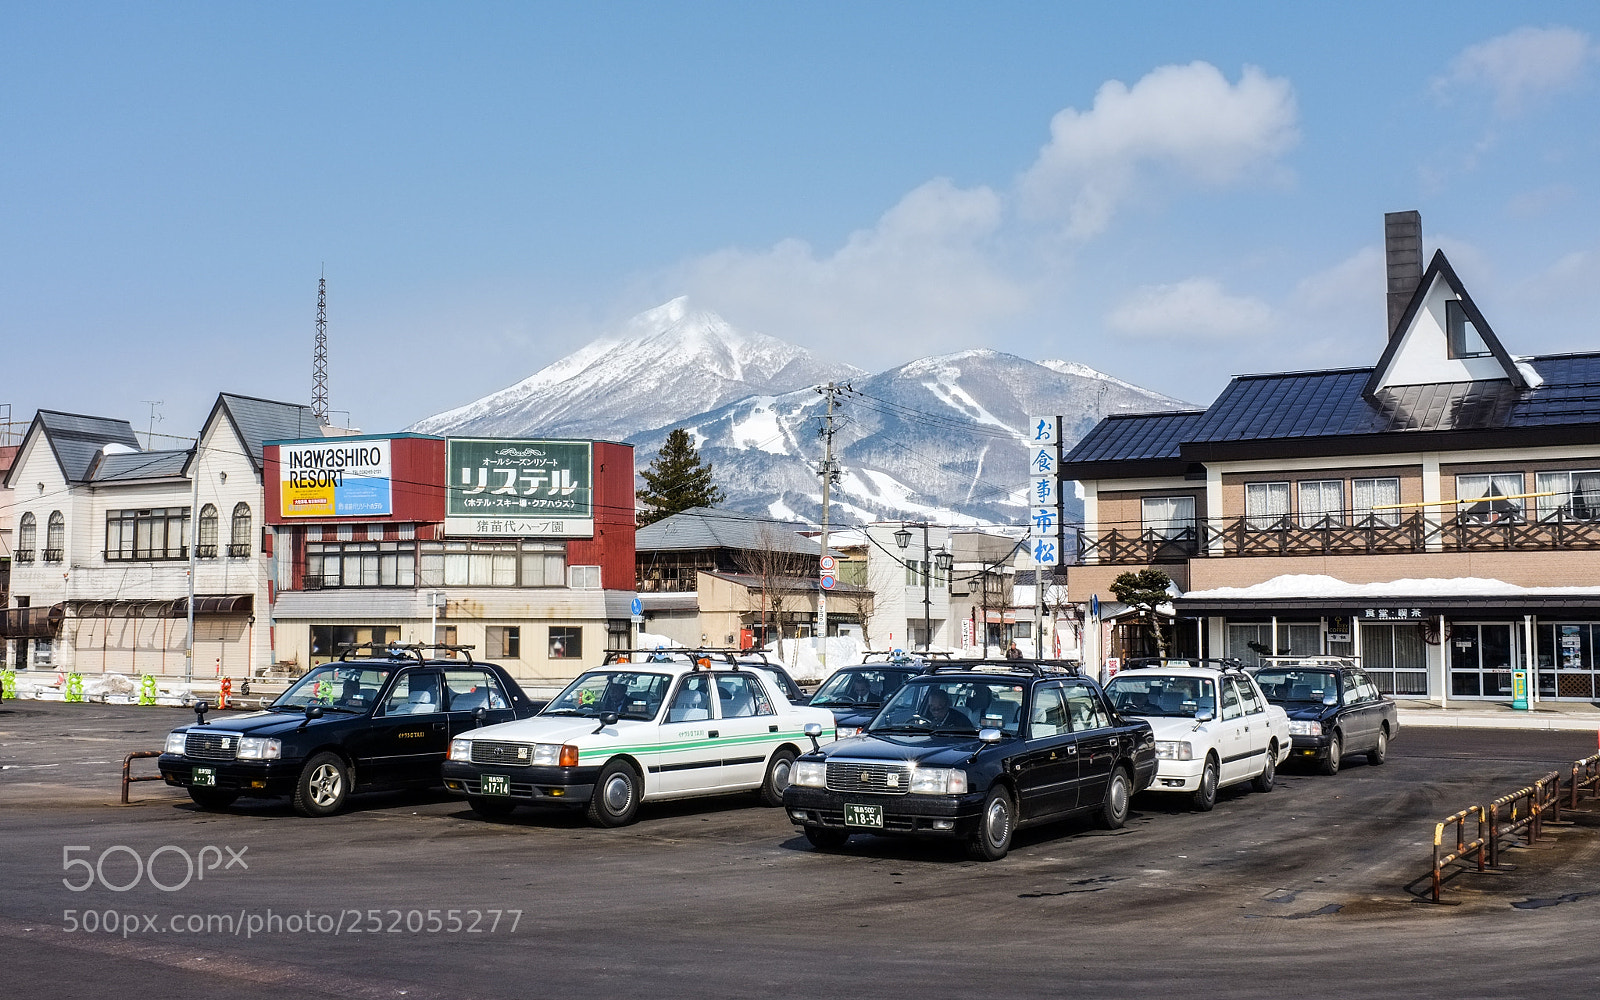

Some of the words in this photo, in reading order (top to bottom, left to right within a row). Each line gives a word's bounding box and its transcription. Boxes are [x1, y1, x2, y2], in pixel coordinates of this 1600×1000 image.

[482, 458, 558, 467] オールシーズンリゾート
[290, 469, 346, 488] RESORT
[462, 467, 579, 496] リステル
[1032, 419, 1057, 563] お食事市松
[477, 520, 564, 533] 猪苗代ハーブ園
[823, 559, 832, 567] 40
[855, 812, 882, 826] 18-54
